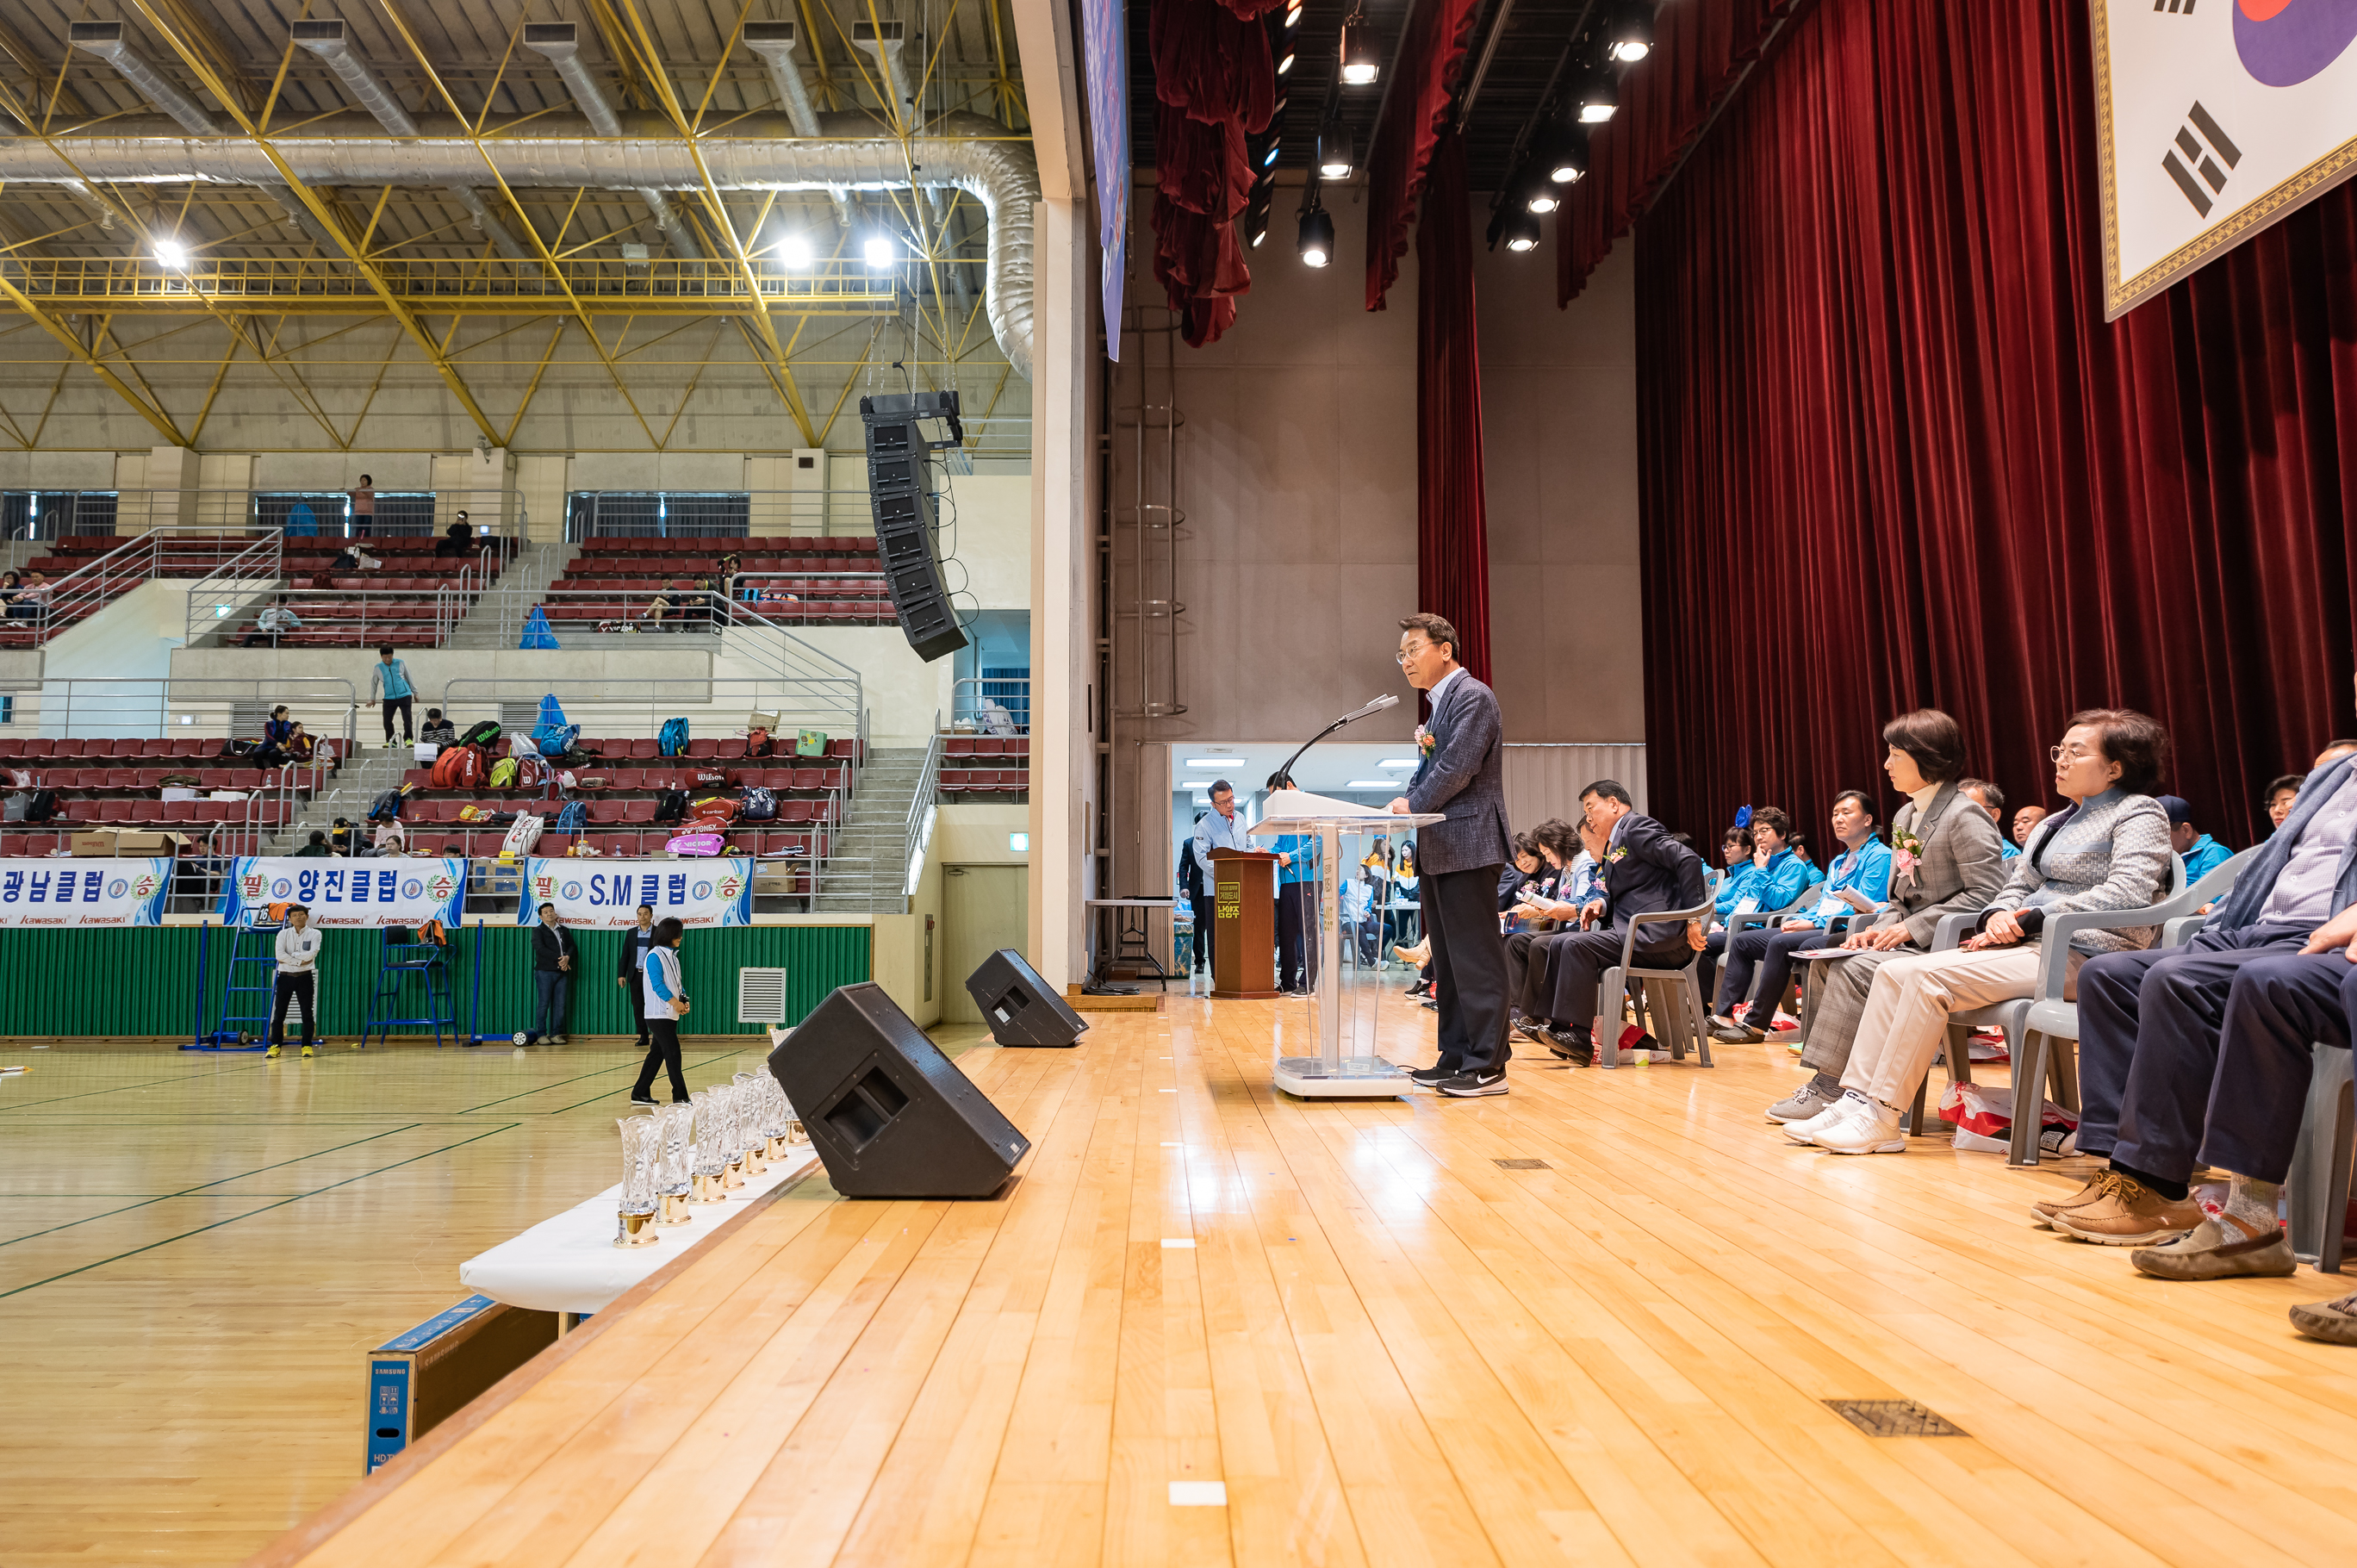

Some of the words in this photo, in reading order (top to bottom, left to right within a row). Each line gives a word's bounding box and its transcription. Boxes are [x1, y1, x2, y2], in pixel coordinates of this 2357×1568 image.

[476, 726, 500, 742] Wilson
[564, 733, 577, 751] Wilson
[3, 870, 104, 903] 광남클럽
[136, 875, 155, 896] 승
[244, 875, 262, 897] 필
[298, 869, 397, 903] 양진클럽
[432, 877, 453, 899] 승
[536, 877, 552, 898] 필
[720, 876, 740, 897] 승
[259, 908, 269, 920] 16
[1217, 905, 1240, 918] 남양주
[425, 1340, 459, 1371] SAMSUNG
[373, 1453, 387, 1463] HD
